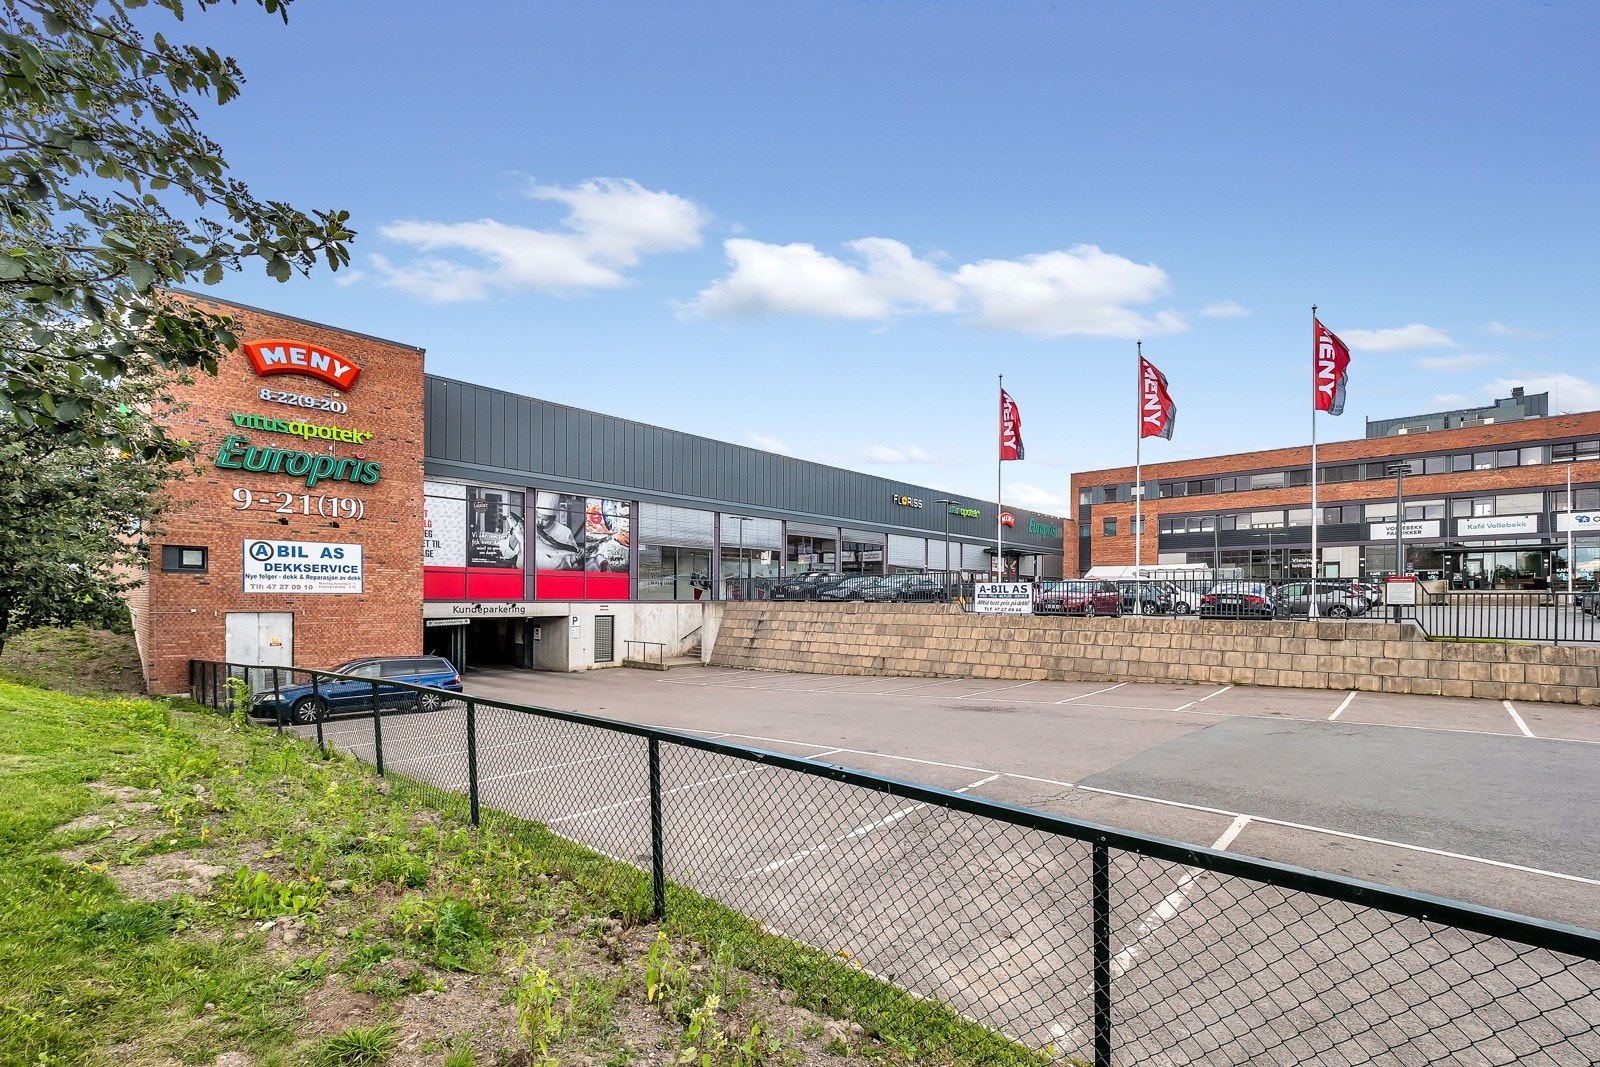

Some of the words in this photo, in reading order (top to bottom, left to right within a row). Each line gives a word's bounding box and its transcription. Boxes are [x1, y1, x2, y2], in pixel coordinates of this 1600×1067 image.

[259, 346, 351, 378] MENY
[1142, 360, 1162, 427] MENY
[259, 388, 348, 414] 8-22(9-20)
[1003, 393, 1017, 450] MENY
[215, 434, 383, 487] Europris
[1028, 516, 1056, 540] Europris
[1467, 522, 1485, 530] Kafé
[1488, 521, 1527, 529] Vollebekk
[432, 540, 441, 549] TIL
[277, 545, 309, 558] BIL
[320, 547, 345, 559] AS
[264, 562, 359, 574] DEKKSERVICE
[245, 573, 258, 581] Nye
[259, 573, 278, 581] felger
[305, 574, 339, 582] Reparasjon
[979, 584, 1009, 594] A-BIL
[1012, 584, 1028, 594] AS
[452, 605, 526, 615] Kundeparkering
[572, 616, 579, 625] P
